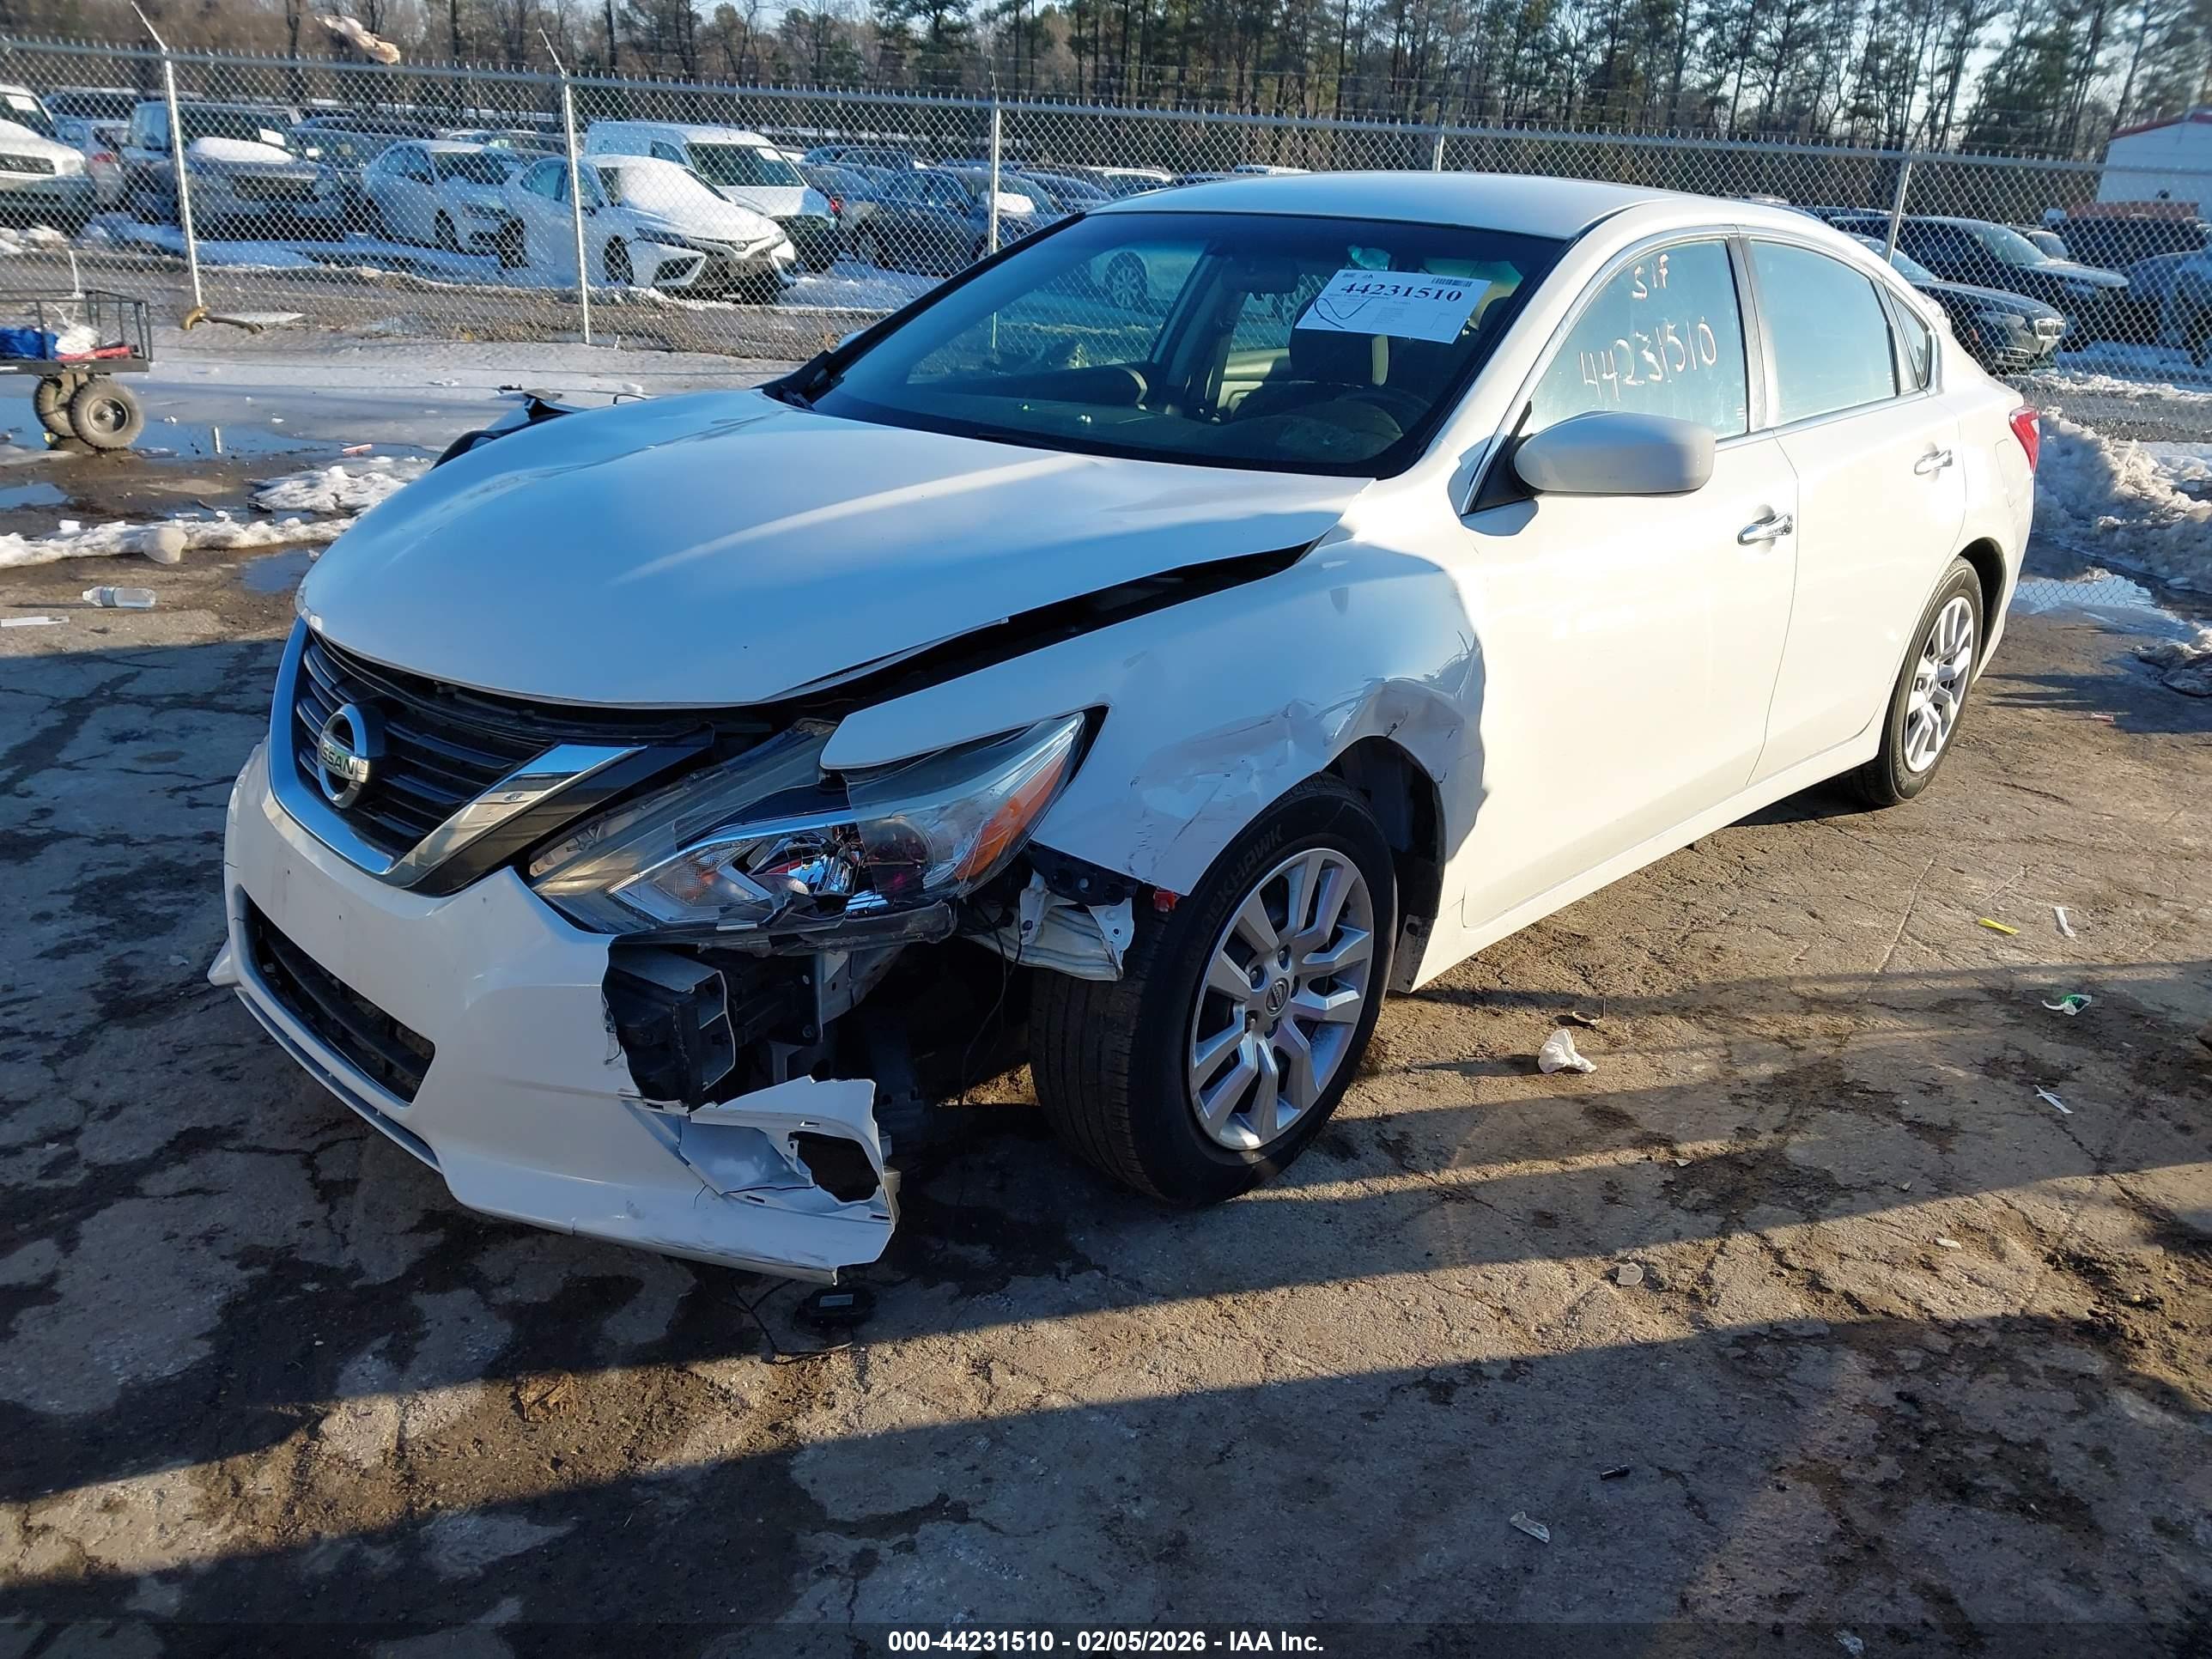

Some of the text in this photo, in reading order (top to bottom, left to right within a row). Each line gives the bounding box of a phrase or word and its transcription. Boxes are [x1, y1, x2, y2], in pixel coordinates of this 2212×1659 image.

[1340, 282, 1462, 301] 44231510
[1579, 315, 1717, 404] 44231510
[320, 746, 355, 775] SSAN
